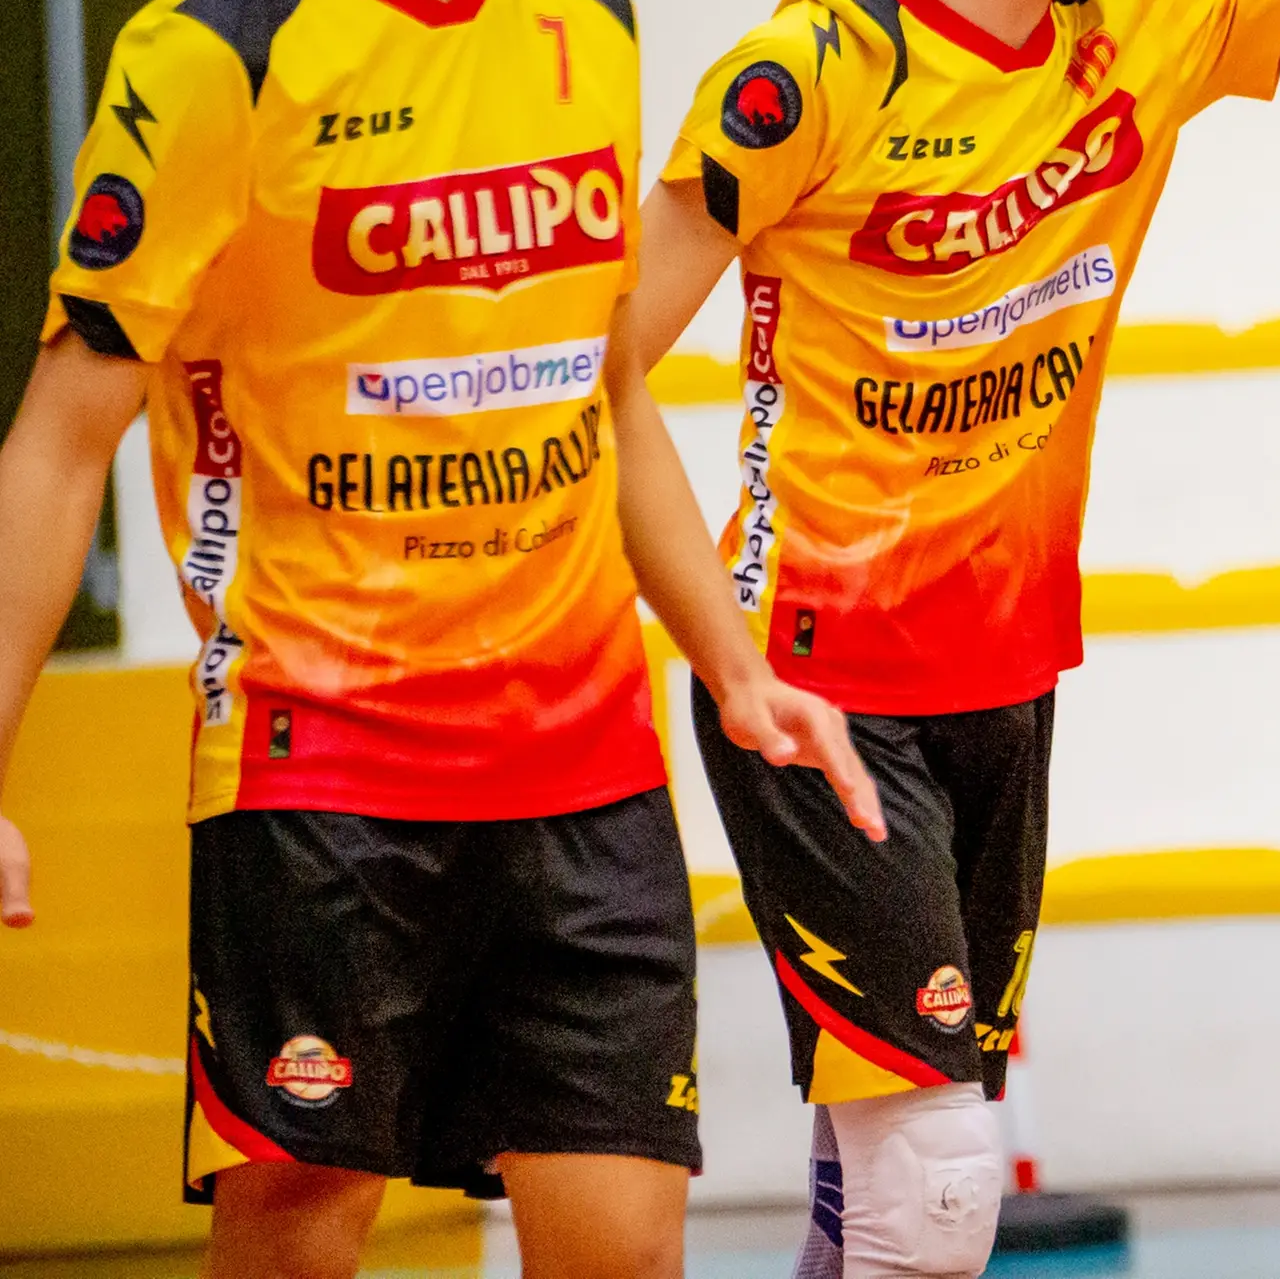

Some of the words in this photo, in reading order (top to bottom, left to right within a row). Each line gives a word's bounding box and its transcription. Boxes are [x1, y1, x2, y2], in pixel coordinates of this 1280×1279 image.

[312, 106, 415, 148] Zeus
[886, 134, 977, 162] Zeus
[347, 167, 621, 274] CALLIPO
[886, 116, 1122, 262] CALLIPO
[853, 361, 1025, 435] GELATERIA
[306, 446, 531, 513] GELATERIA
[924, 455, 981, 477] Pizzo
[988, 440, 1011, 464] di
[402, 535, 475, 561] Pizzo
[482, 527, 508, 559] di
[996, 929, 1035, 1018] 1
